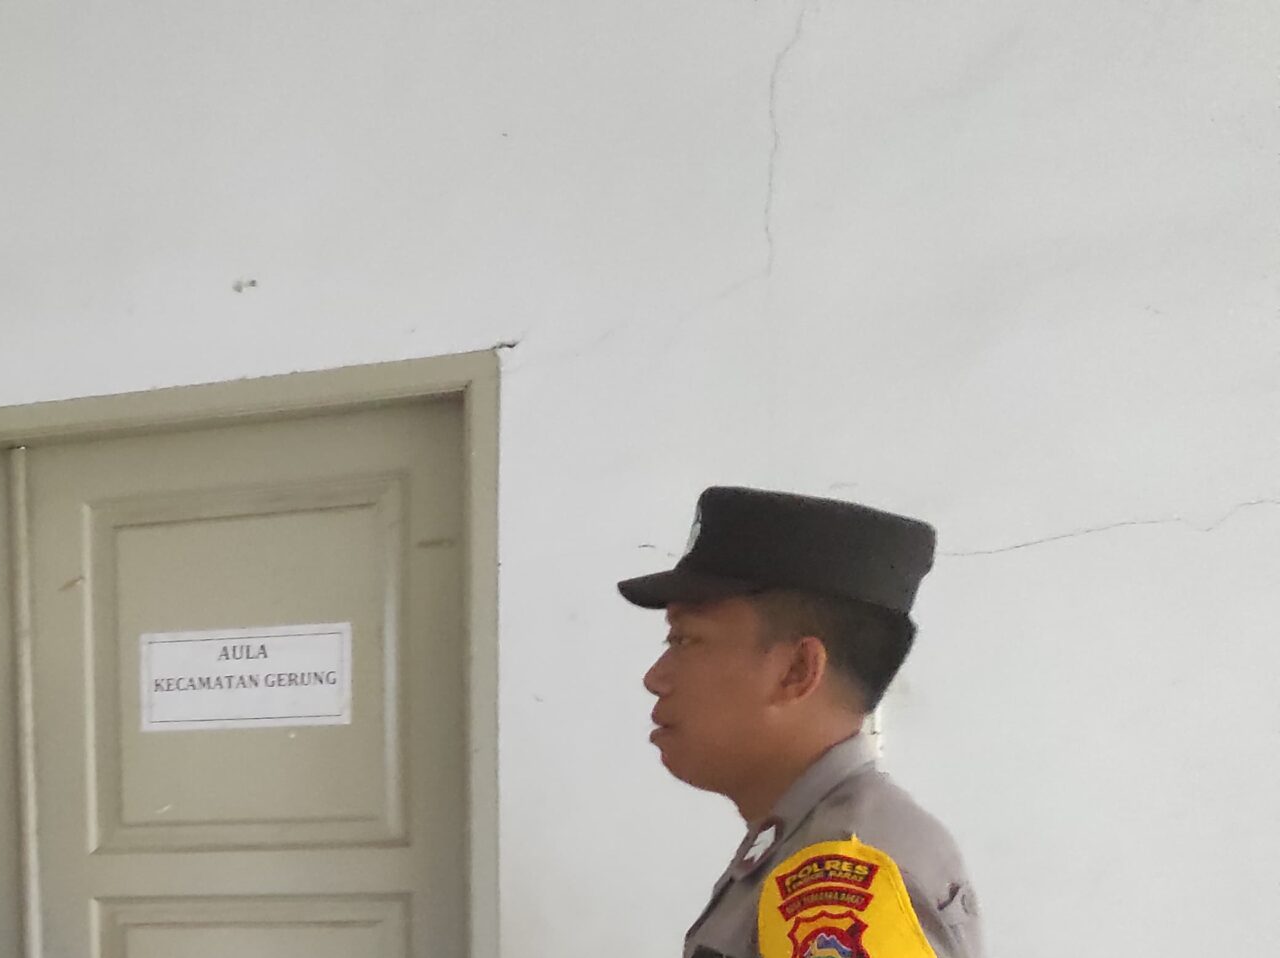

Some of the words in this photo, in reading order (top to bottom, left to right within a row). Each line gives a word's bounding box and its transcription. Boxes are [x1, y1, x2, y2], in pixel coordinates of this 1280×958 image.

[217, 644, 269, 661] AULA
[153, 674, 260, 693] KECAMATAN
[263, 670, 338, 689] GERUNG
[784, 859, 870, 894] POLRES
